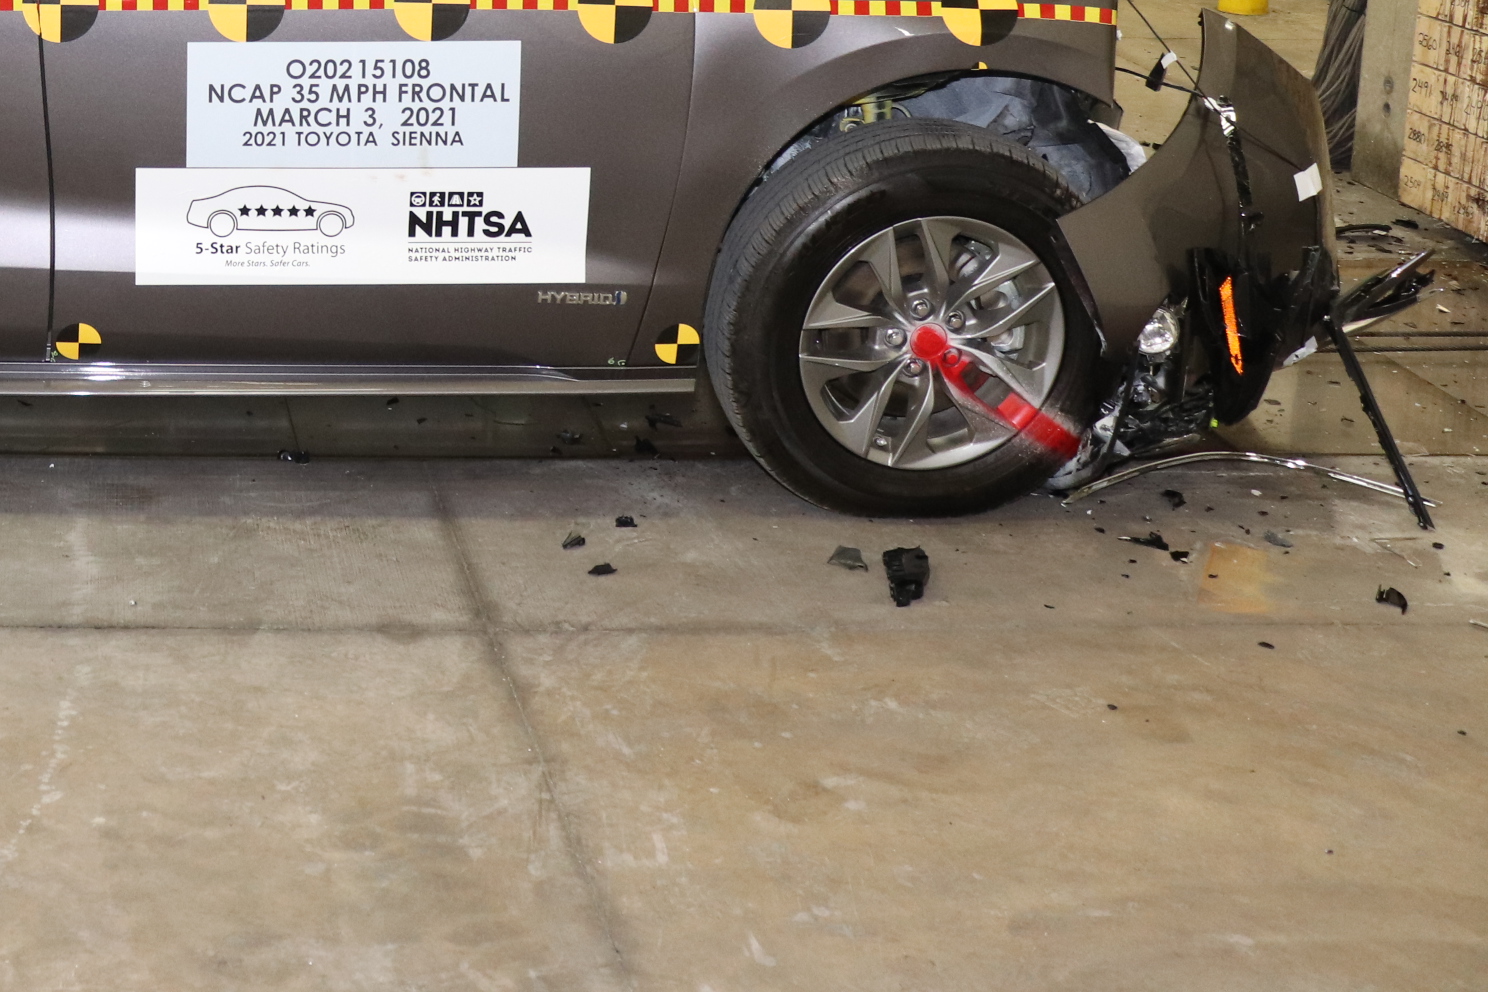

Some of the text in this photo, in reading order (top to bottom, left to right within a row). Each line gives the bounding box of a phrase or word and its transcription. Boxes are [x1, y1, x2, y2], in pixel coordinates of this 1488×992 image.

[286, 58, 431, 80] O20215108
[208, 82, 510, 104] NCAP 35 MPH FRONTAL
[253, 106, 457, 129] MARCH 3, 2021
[242, 130, 464, 147] 2021 TOYOTA SIENNA
[408, 210, 532, 238] NHTSA
[195, 241, 346, 257] 5-Star Safety Ratings
[225, 259, 310, 267] More Stars. Safer Cars.
[537, 291, 615, 305] HYBRID
